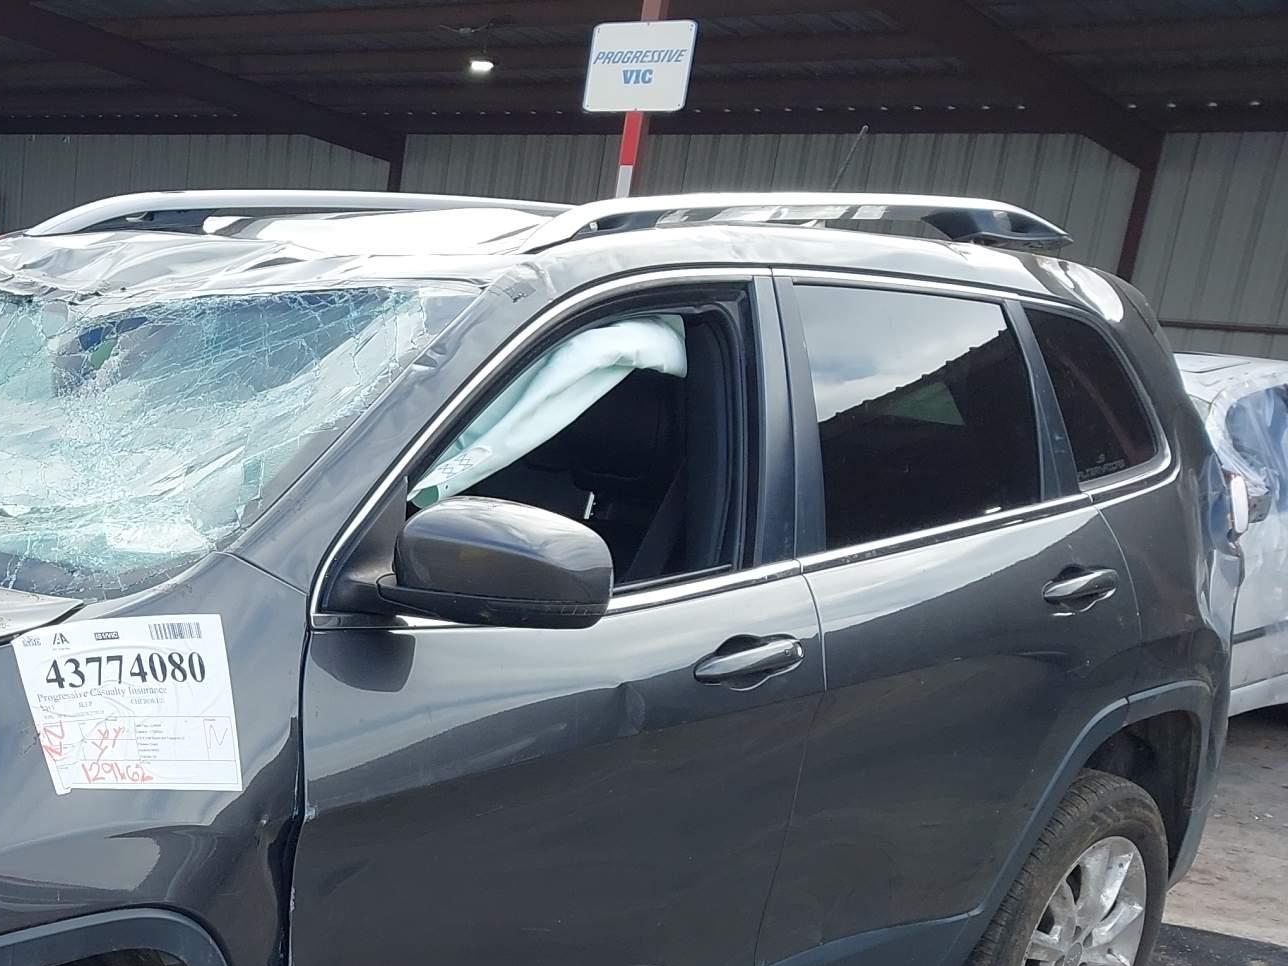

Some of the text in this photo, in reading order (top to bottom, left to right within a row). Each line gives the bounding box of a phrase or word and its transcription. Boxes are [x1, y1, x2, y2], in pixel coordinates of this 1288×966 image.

[593, 49, 687, 64] PROGRESSIVE
[622, 69, 653, 84] VIC
[45, 651, 206, 689] 43774080
[37, 685, 168, 702] Progressive Casualty Insurance
